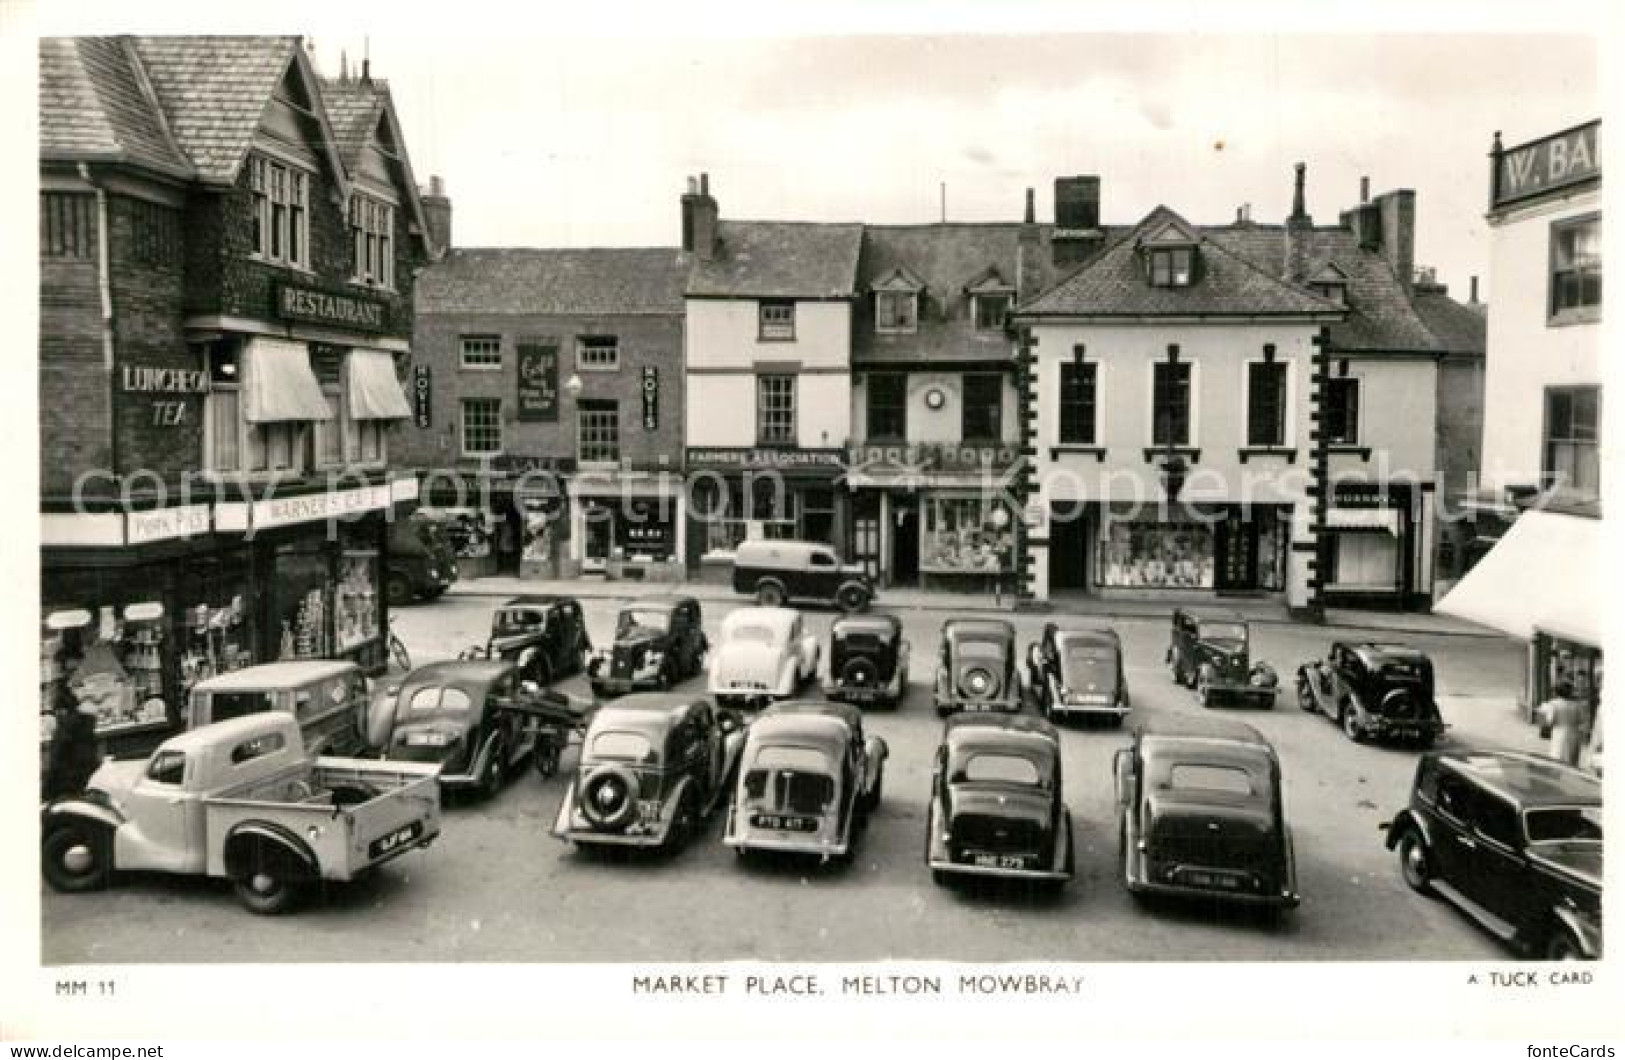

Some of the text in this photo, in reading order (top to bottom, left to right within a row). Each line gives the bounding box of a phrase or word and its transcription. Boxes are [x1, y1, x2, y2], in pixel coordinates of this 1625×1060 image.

[1506, 148, 1540, 193] W.
[284, 287, 382, 326] RESTAURANT
[417, 367, 428, 428] HOVIS
[645, 367, 656, 429] HOVIS
[752, 452, 841, 466] ASSOCIATION
